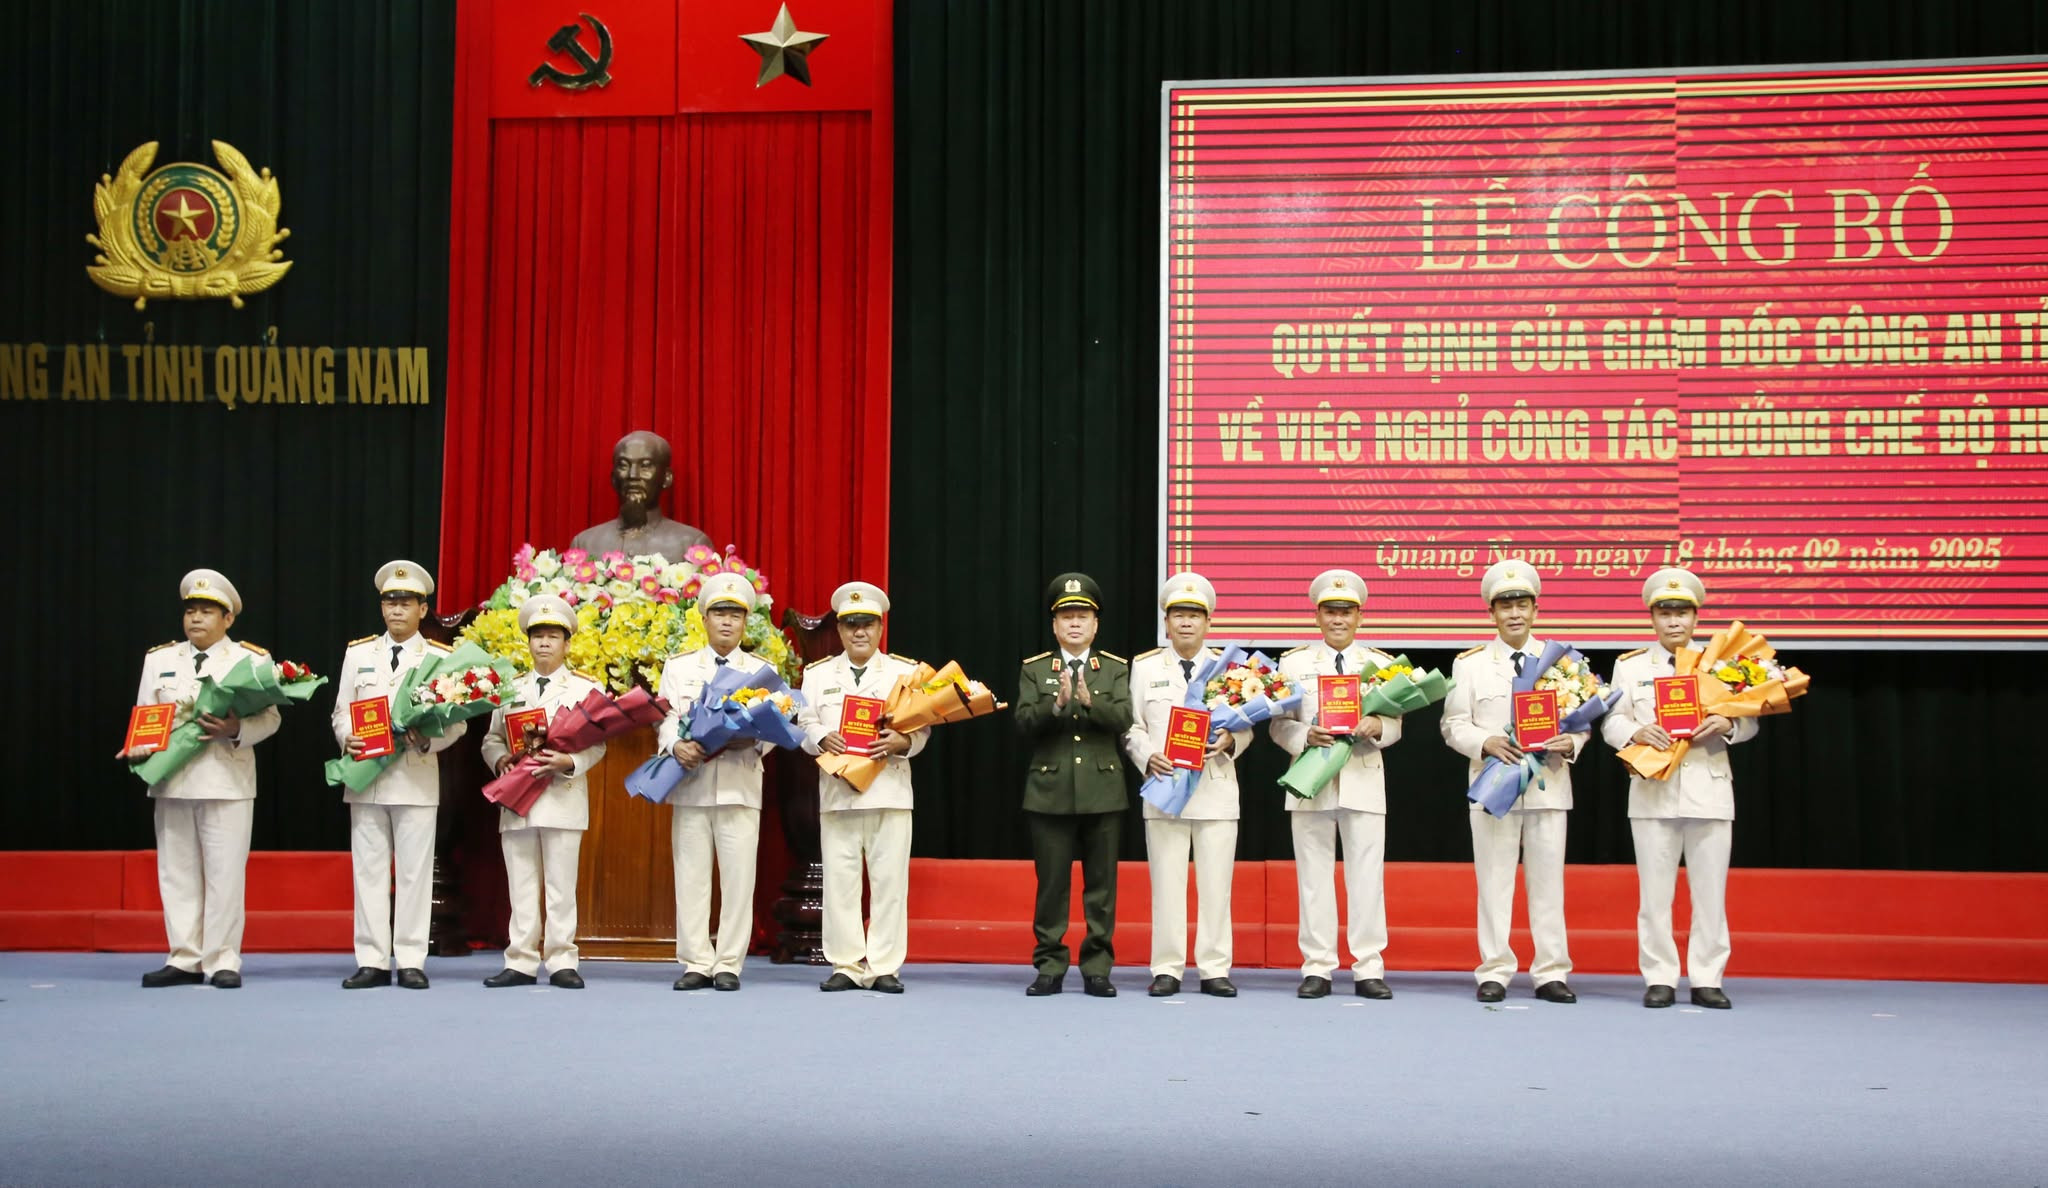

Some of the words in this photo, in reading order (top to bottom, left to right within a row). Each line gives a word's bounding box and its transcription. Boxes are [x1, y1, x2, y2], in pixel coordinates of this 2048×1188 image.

[1414, 174, 1519, 270] LỄ
[1545, 172, 1801, 269] CÔNG
[1825, 162, 1954, 263] BỐ
[0, 342, 48, 401] NG
[62, 343, 110, 401] AN
[122, 322, 205, 402] TỈNH
[215, 325, 335, 411] QUẢNG
[347, 346, 430, 405] NAM
[1271, 306, 1392, 379] QUYẾT
[1402, 321, 1498, 383] ĐỊNH
[1510, 303, 1592, 371] CỦA
[1602, 307, 1707, 370] GIÁM
[1718, 302, 1802, 369] ĐỐC
[1814, 305, 1929, 368] CÔNG
[1943, 312, 2002, 365] AN
[1218, 395, 1264, 462] VỀ
[1276, 400, 1363, 473] VIỆC
[1375, 393, 1470, 462] NGHỈ
[1481, 399, 1590, 461] CÔNG
[1602, 398, 1678, 460] TÁC
[1691, 390, 1831, 457] HƯỞNG
[1844, 388, 1925, 455] CHẾ
[1938, 393, 1995, 468] ĐỘ
[1376, 536, 1478, 577] Quảng
[1573, 538, 1651, 577] ngày
[1658, 538, 1696, 570] 18
[1702, 538, 1799, 575] tháng
[1803, 538, 1842, 570] 02
[1847, 537, 1920, 570] năm
[1926, 537, 2004, 570] 2025
